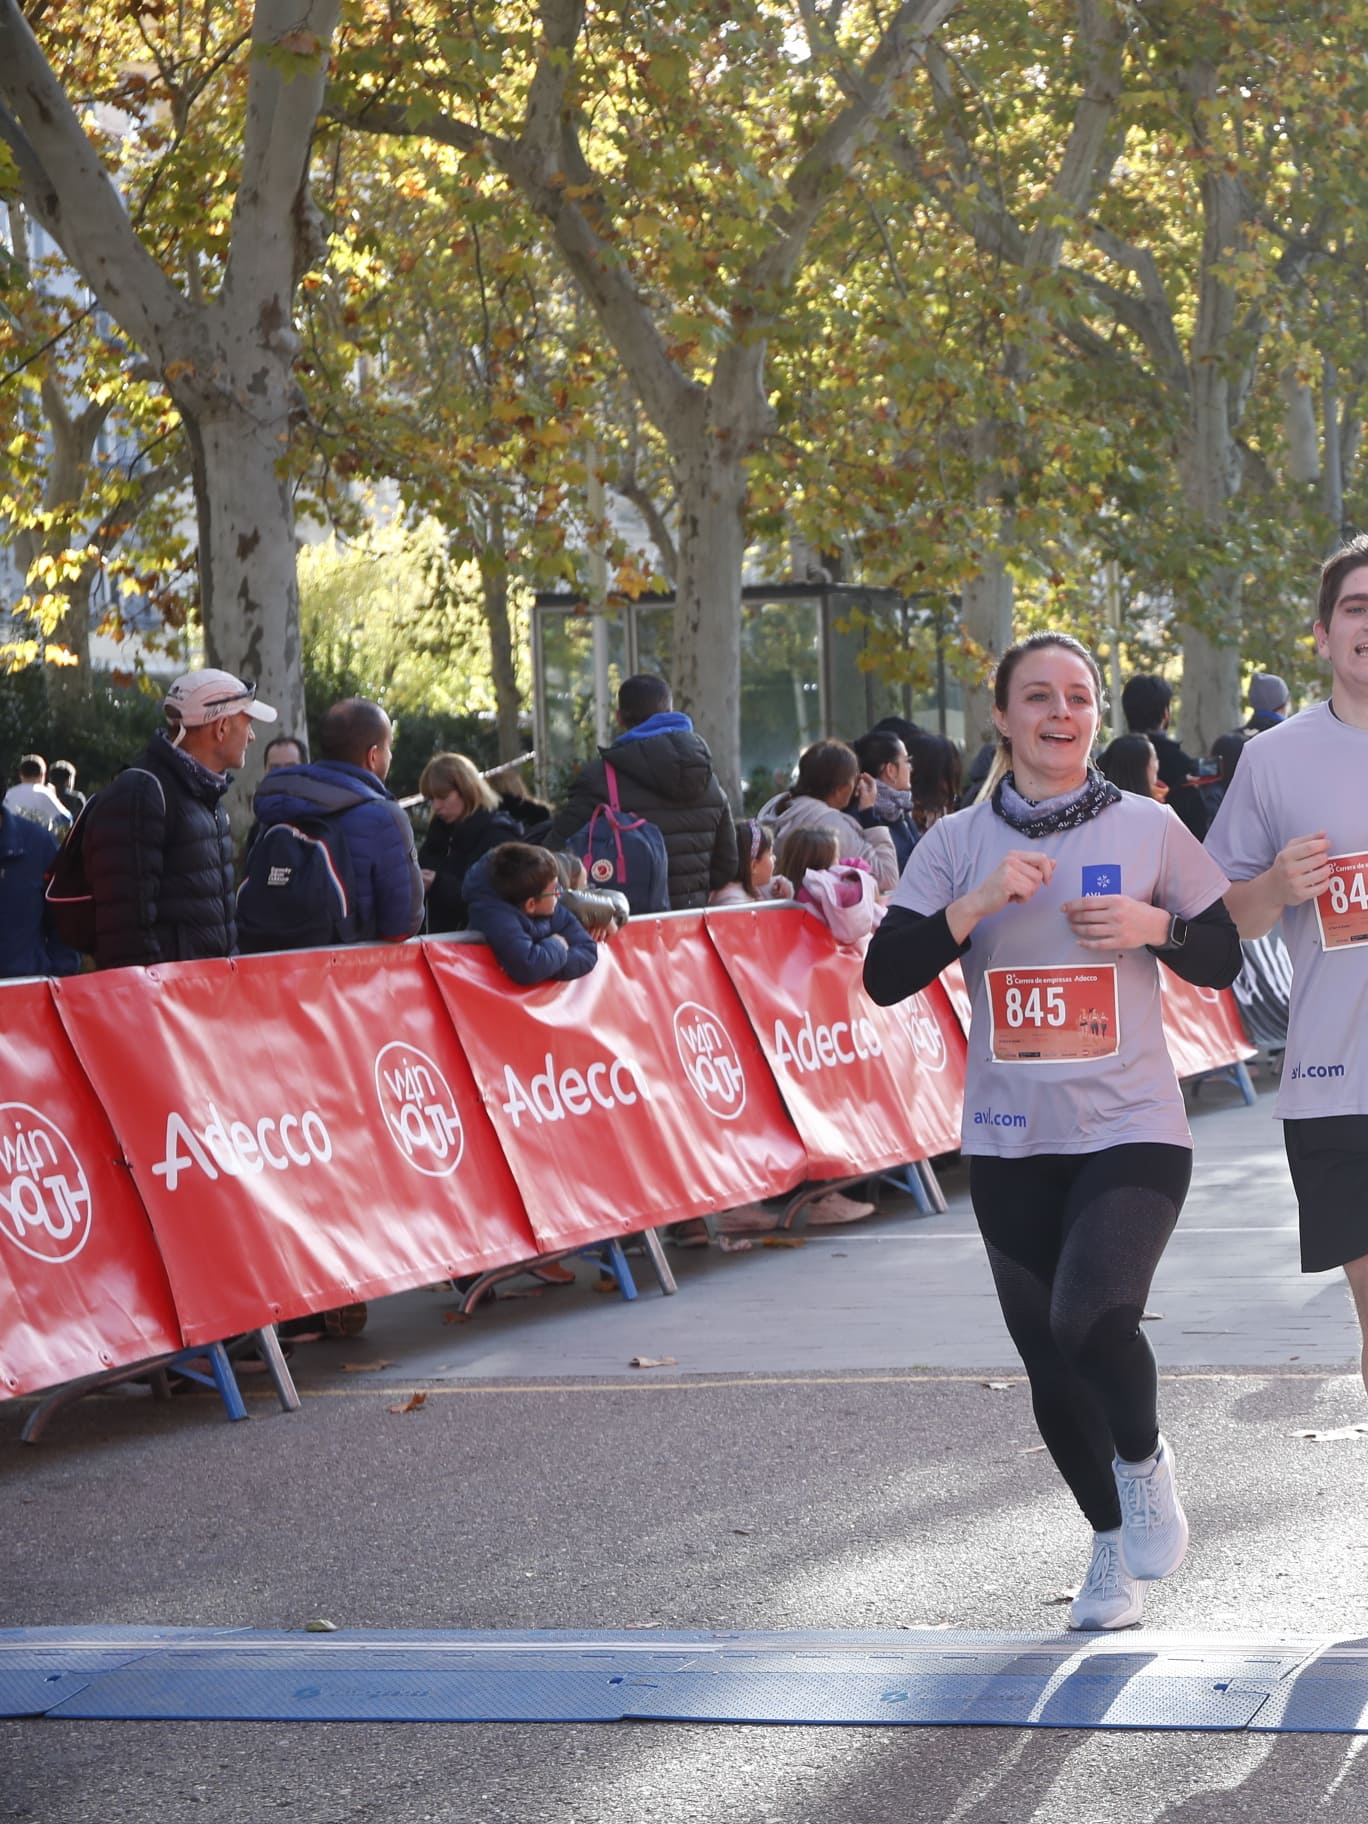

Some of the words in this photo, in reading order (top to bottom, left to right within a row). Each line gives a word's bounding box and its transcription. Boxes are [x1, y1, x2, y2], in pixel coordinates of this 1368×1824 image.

[1065, 803, 1081, 817] AVL
[1335, 864, 1356, 873] Carrera
[1034, 976, 1042, 984] de
[1042, 976, 1073, 985] empresas
[1074, 974, 1098, 982] Adecco
[1005, 986, 1067, 1028] 845
[774, 1011, 882, 1073] Adecco
[974, 1106, 1027, 1127] avl.com
[151, 1102, 333, 1191] Adecco
